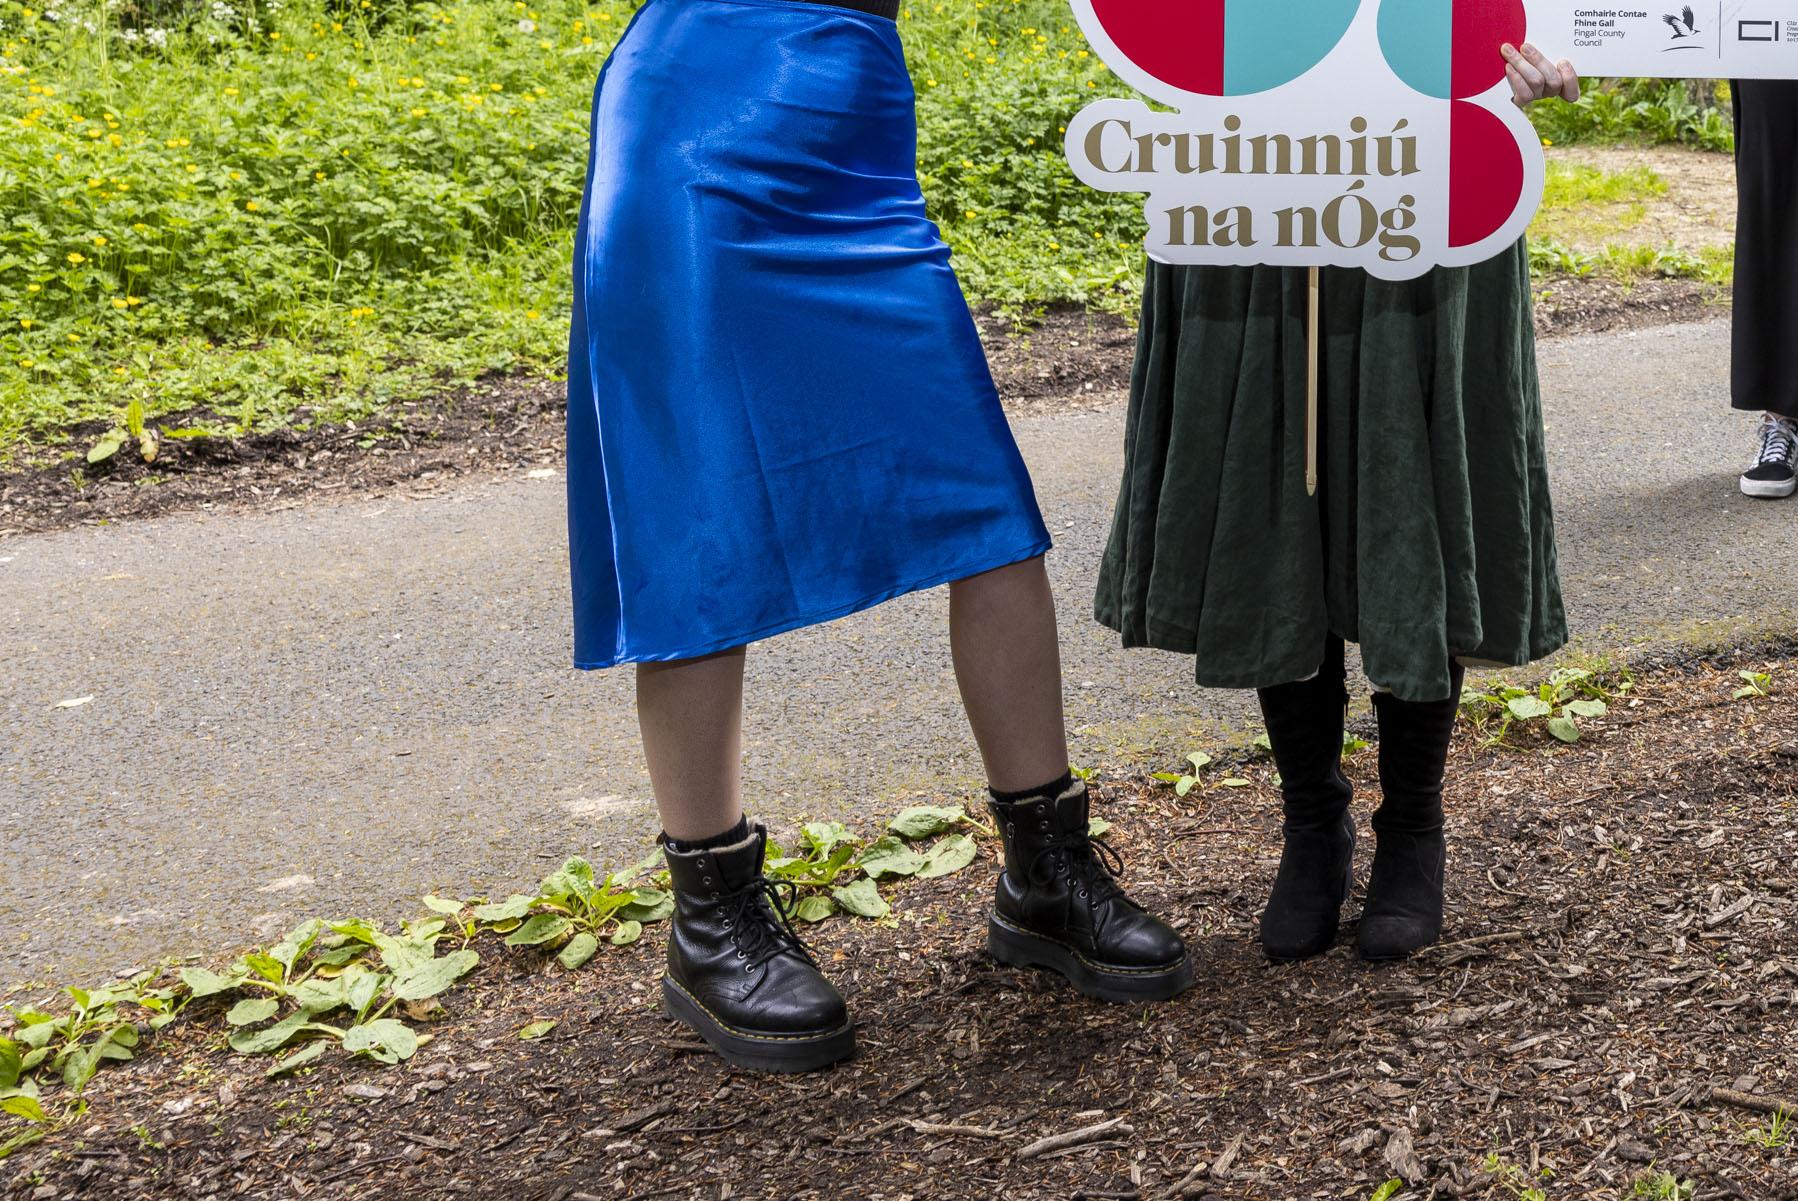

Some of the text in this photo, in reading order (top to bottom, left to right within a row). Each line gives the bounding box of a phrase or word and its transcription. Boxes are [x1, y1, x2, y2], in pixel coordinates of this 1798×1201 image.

[1574, 9, 1648, 18] Comhairle Contae
[1574, 19, 1615, 27] Fhine Gall
[1574, 29, 1626, 38] Fingal County
[1084, 114, 1421, 177] Cruinniú
[1162, 178, 1422, 262] na nÓg
